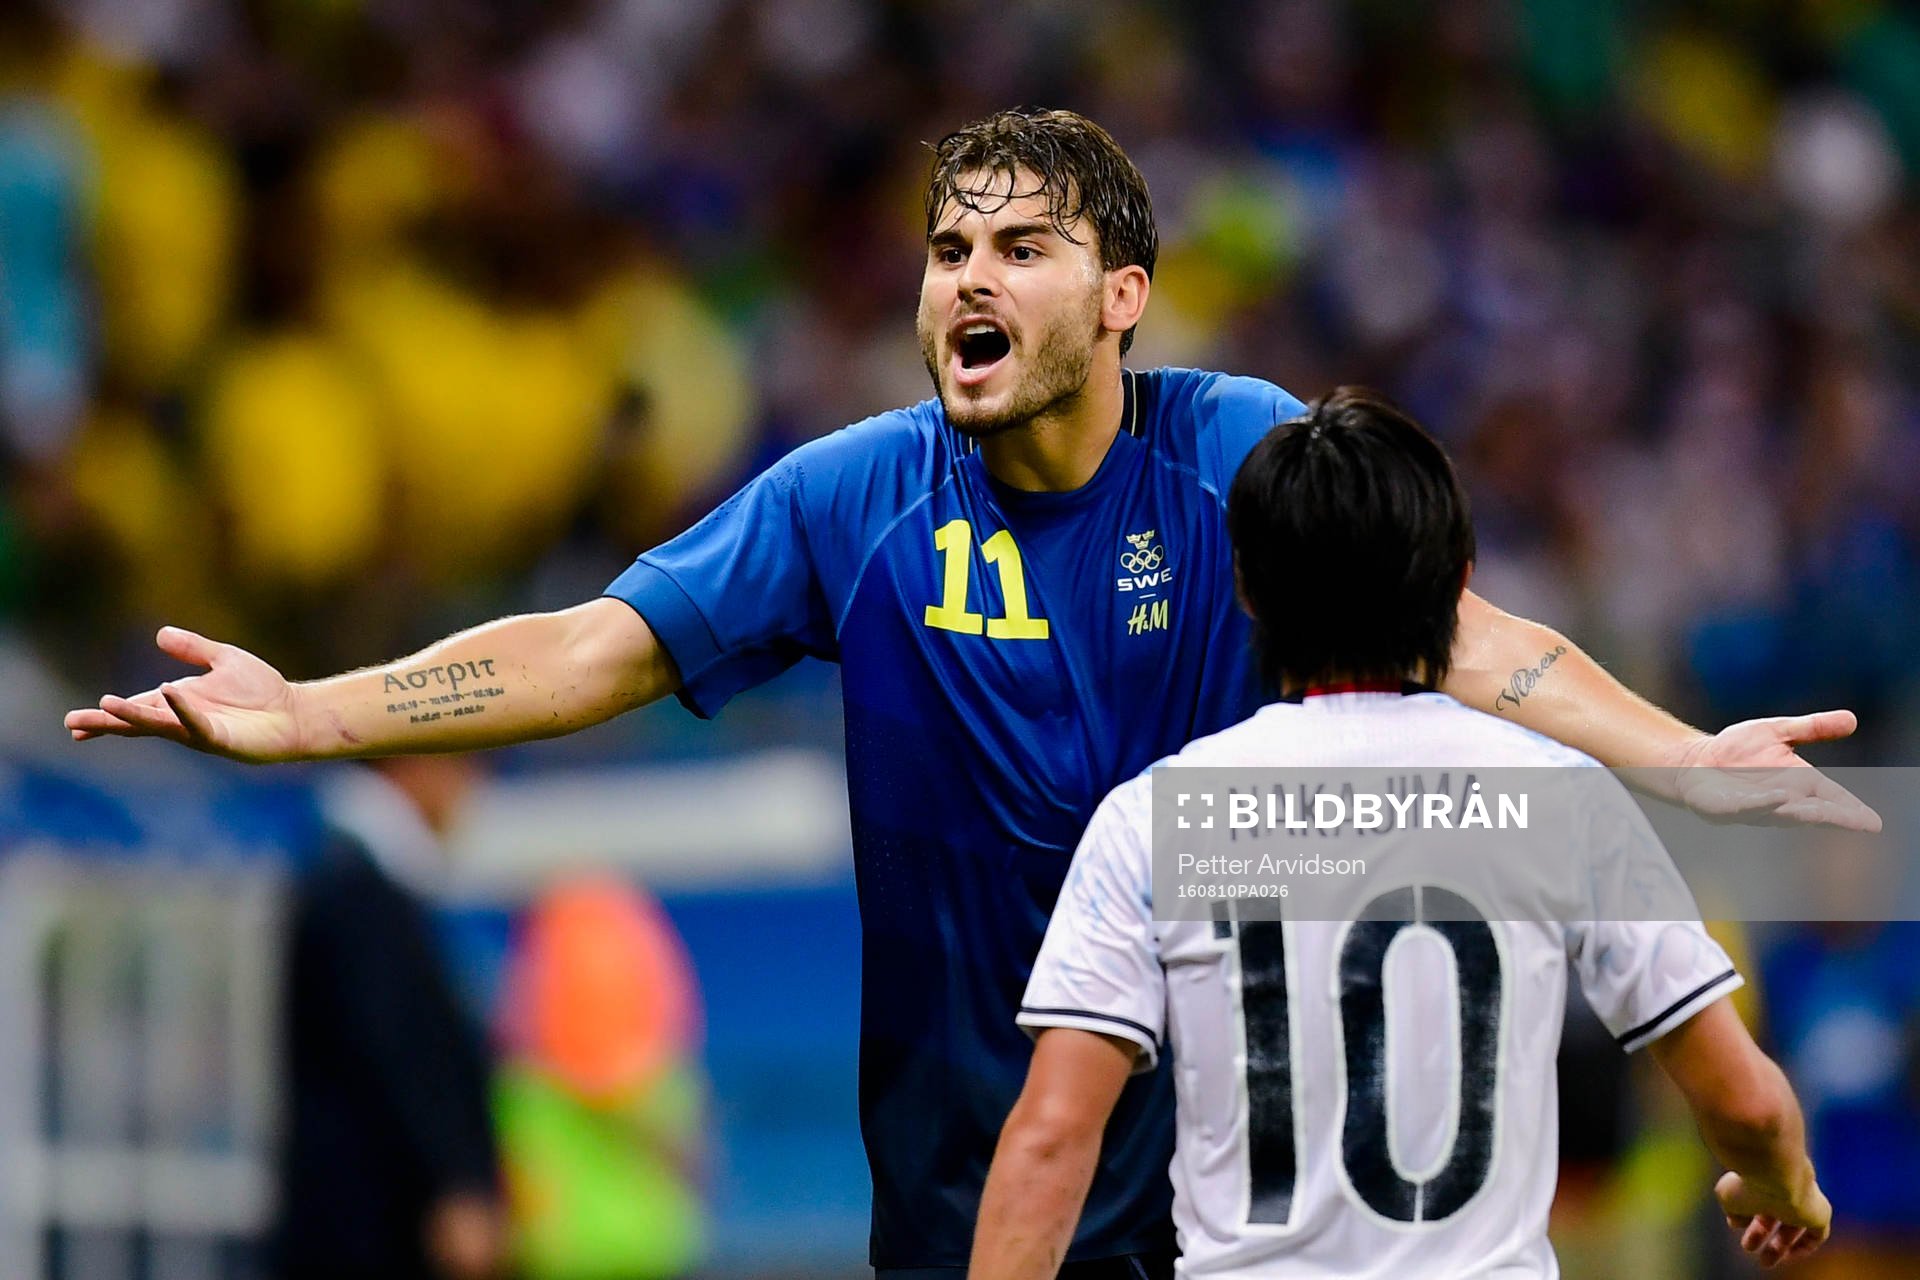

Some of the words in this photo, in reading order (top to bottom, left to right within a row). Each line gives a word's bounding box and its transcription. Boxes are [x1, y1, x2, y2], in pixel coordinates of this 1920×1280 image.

[924, 519, 1049, 639] 11
[1117, 568, 1173, 591] SWE
[1127, 599, 1168, 635] H&M
[1210, 886, 1503, 1224] 10
